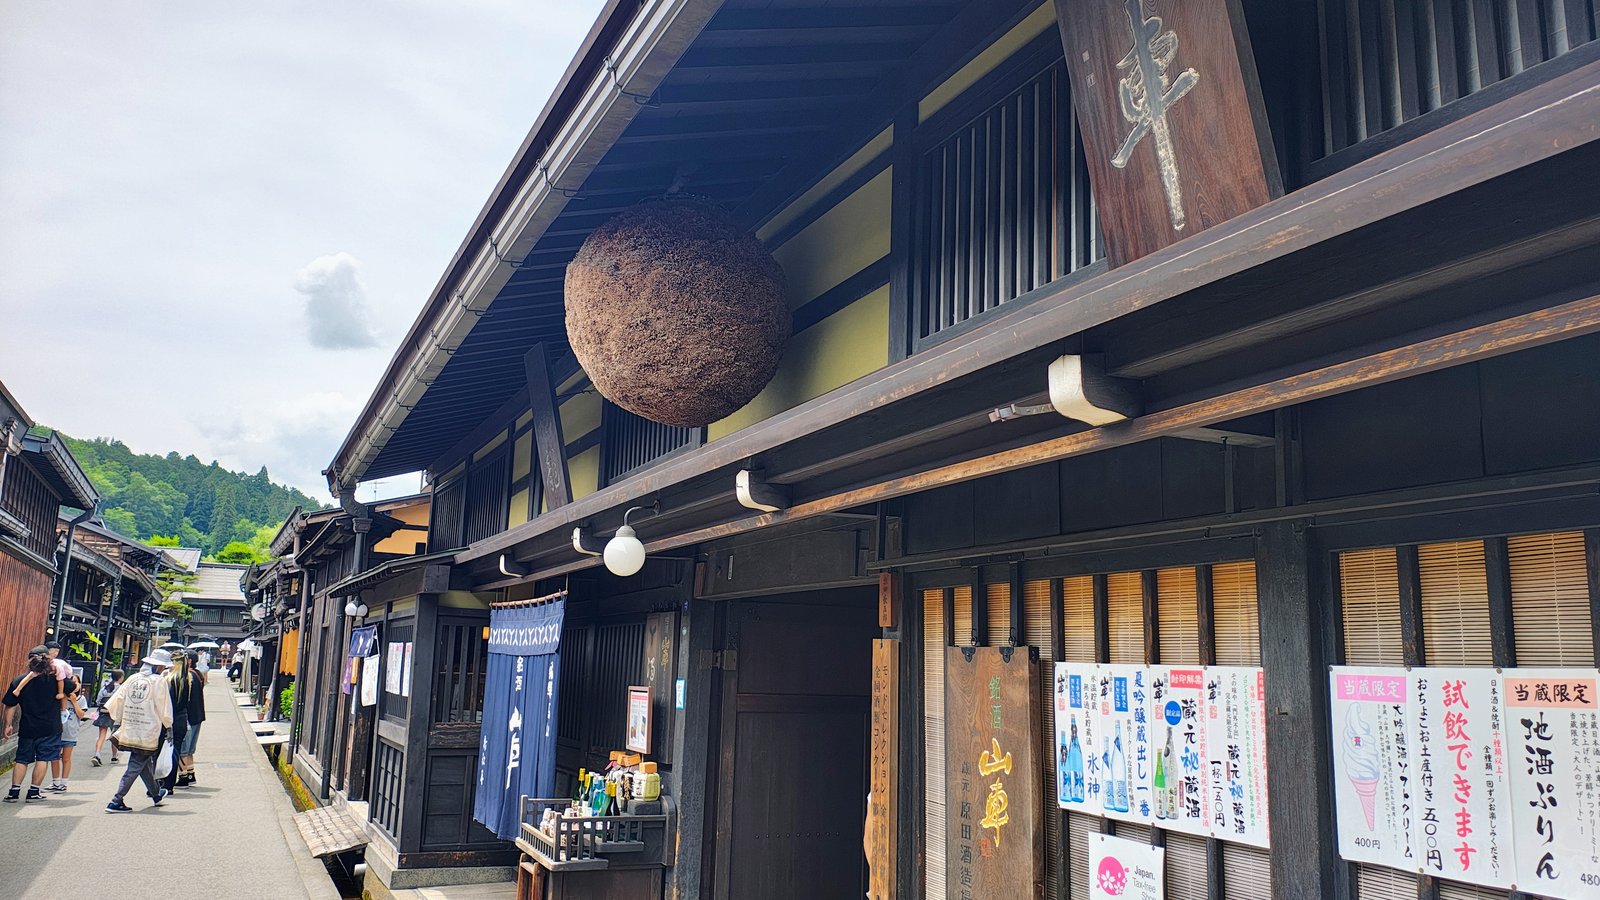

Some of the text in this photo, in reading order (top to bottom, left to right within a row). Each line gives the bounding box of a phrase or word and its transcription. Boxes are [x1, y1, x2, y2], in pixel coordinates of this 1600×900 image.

[988, 675, 1002, 729] 銘酒
[1344, 679, 1402, 699] 当蔵限定
[1515, 683, 1591, 704] 当蔵限定
[1088, 752, 1100, 801] 氷神
[1133, 671, 1151, 817] 夏吟醸蔵出し一番
[1181, 698, 1200, 818] 蔵元秘蔵酒
[1417, 678, 1433, 802] おちょこお土産付き
[1442, 679, 1477, 872] 試飲できます
[978, 737, 1013, 848] 山車
[1228, 744, 1245, 834] 蔵元秘蔵酒
[1520, 711, 1560, 880] 地酒ぷりん
[1134, 865, 1156, 881] Japan.
[1354, 837, 1381, 849] 400円
